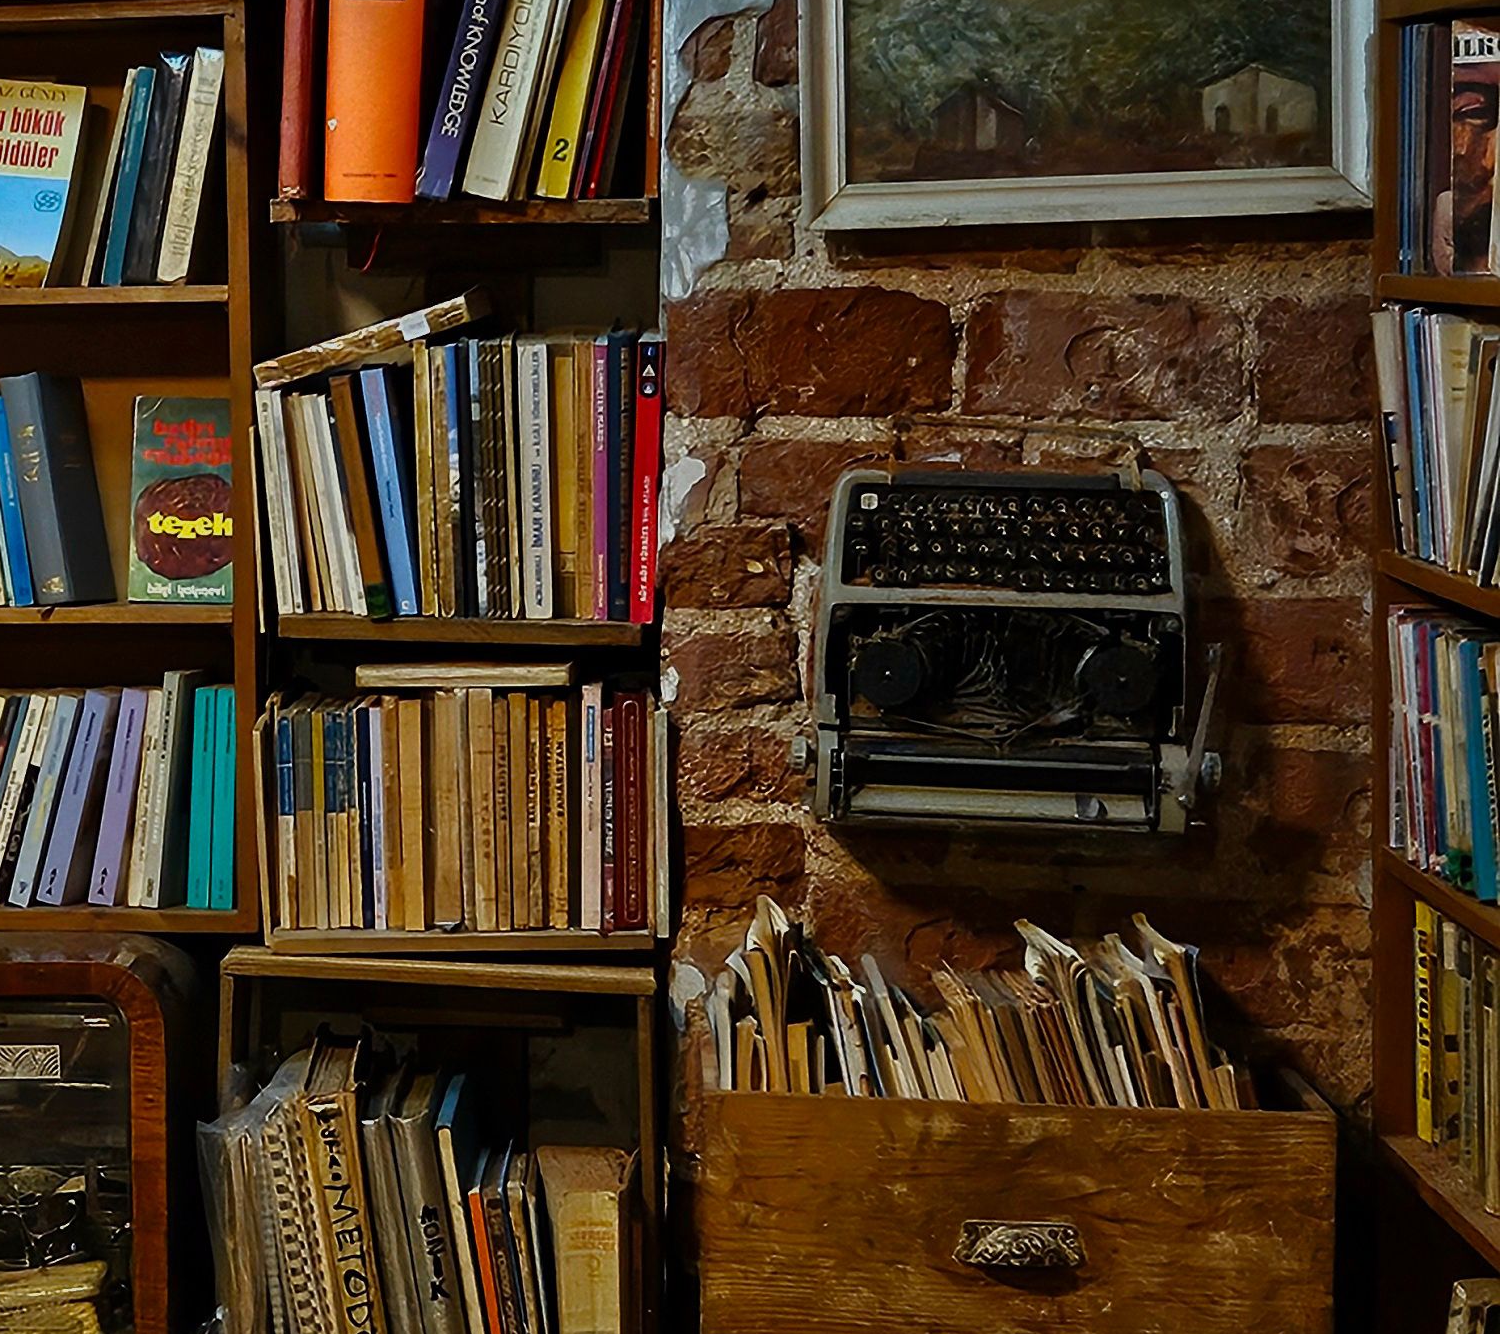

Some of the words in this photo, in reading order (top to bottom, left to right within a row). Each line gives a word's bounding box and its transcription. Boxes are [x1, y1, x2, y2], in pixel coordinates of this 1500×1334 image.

[19, 84, 68, 102] GÜNEY
[440, 24, 486, 137] KNOWLEDGE
[9, 107, 66, 137] bükük
[551, 137, 571, 162] 2
[531, 462, 543, 514] KANUNU
[146, 510, 234, 539] tezek
